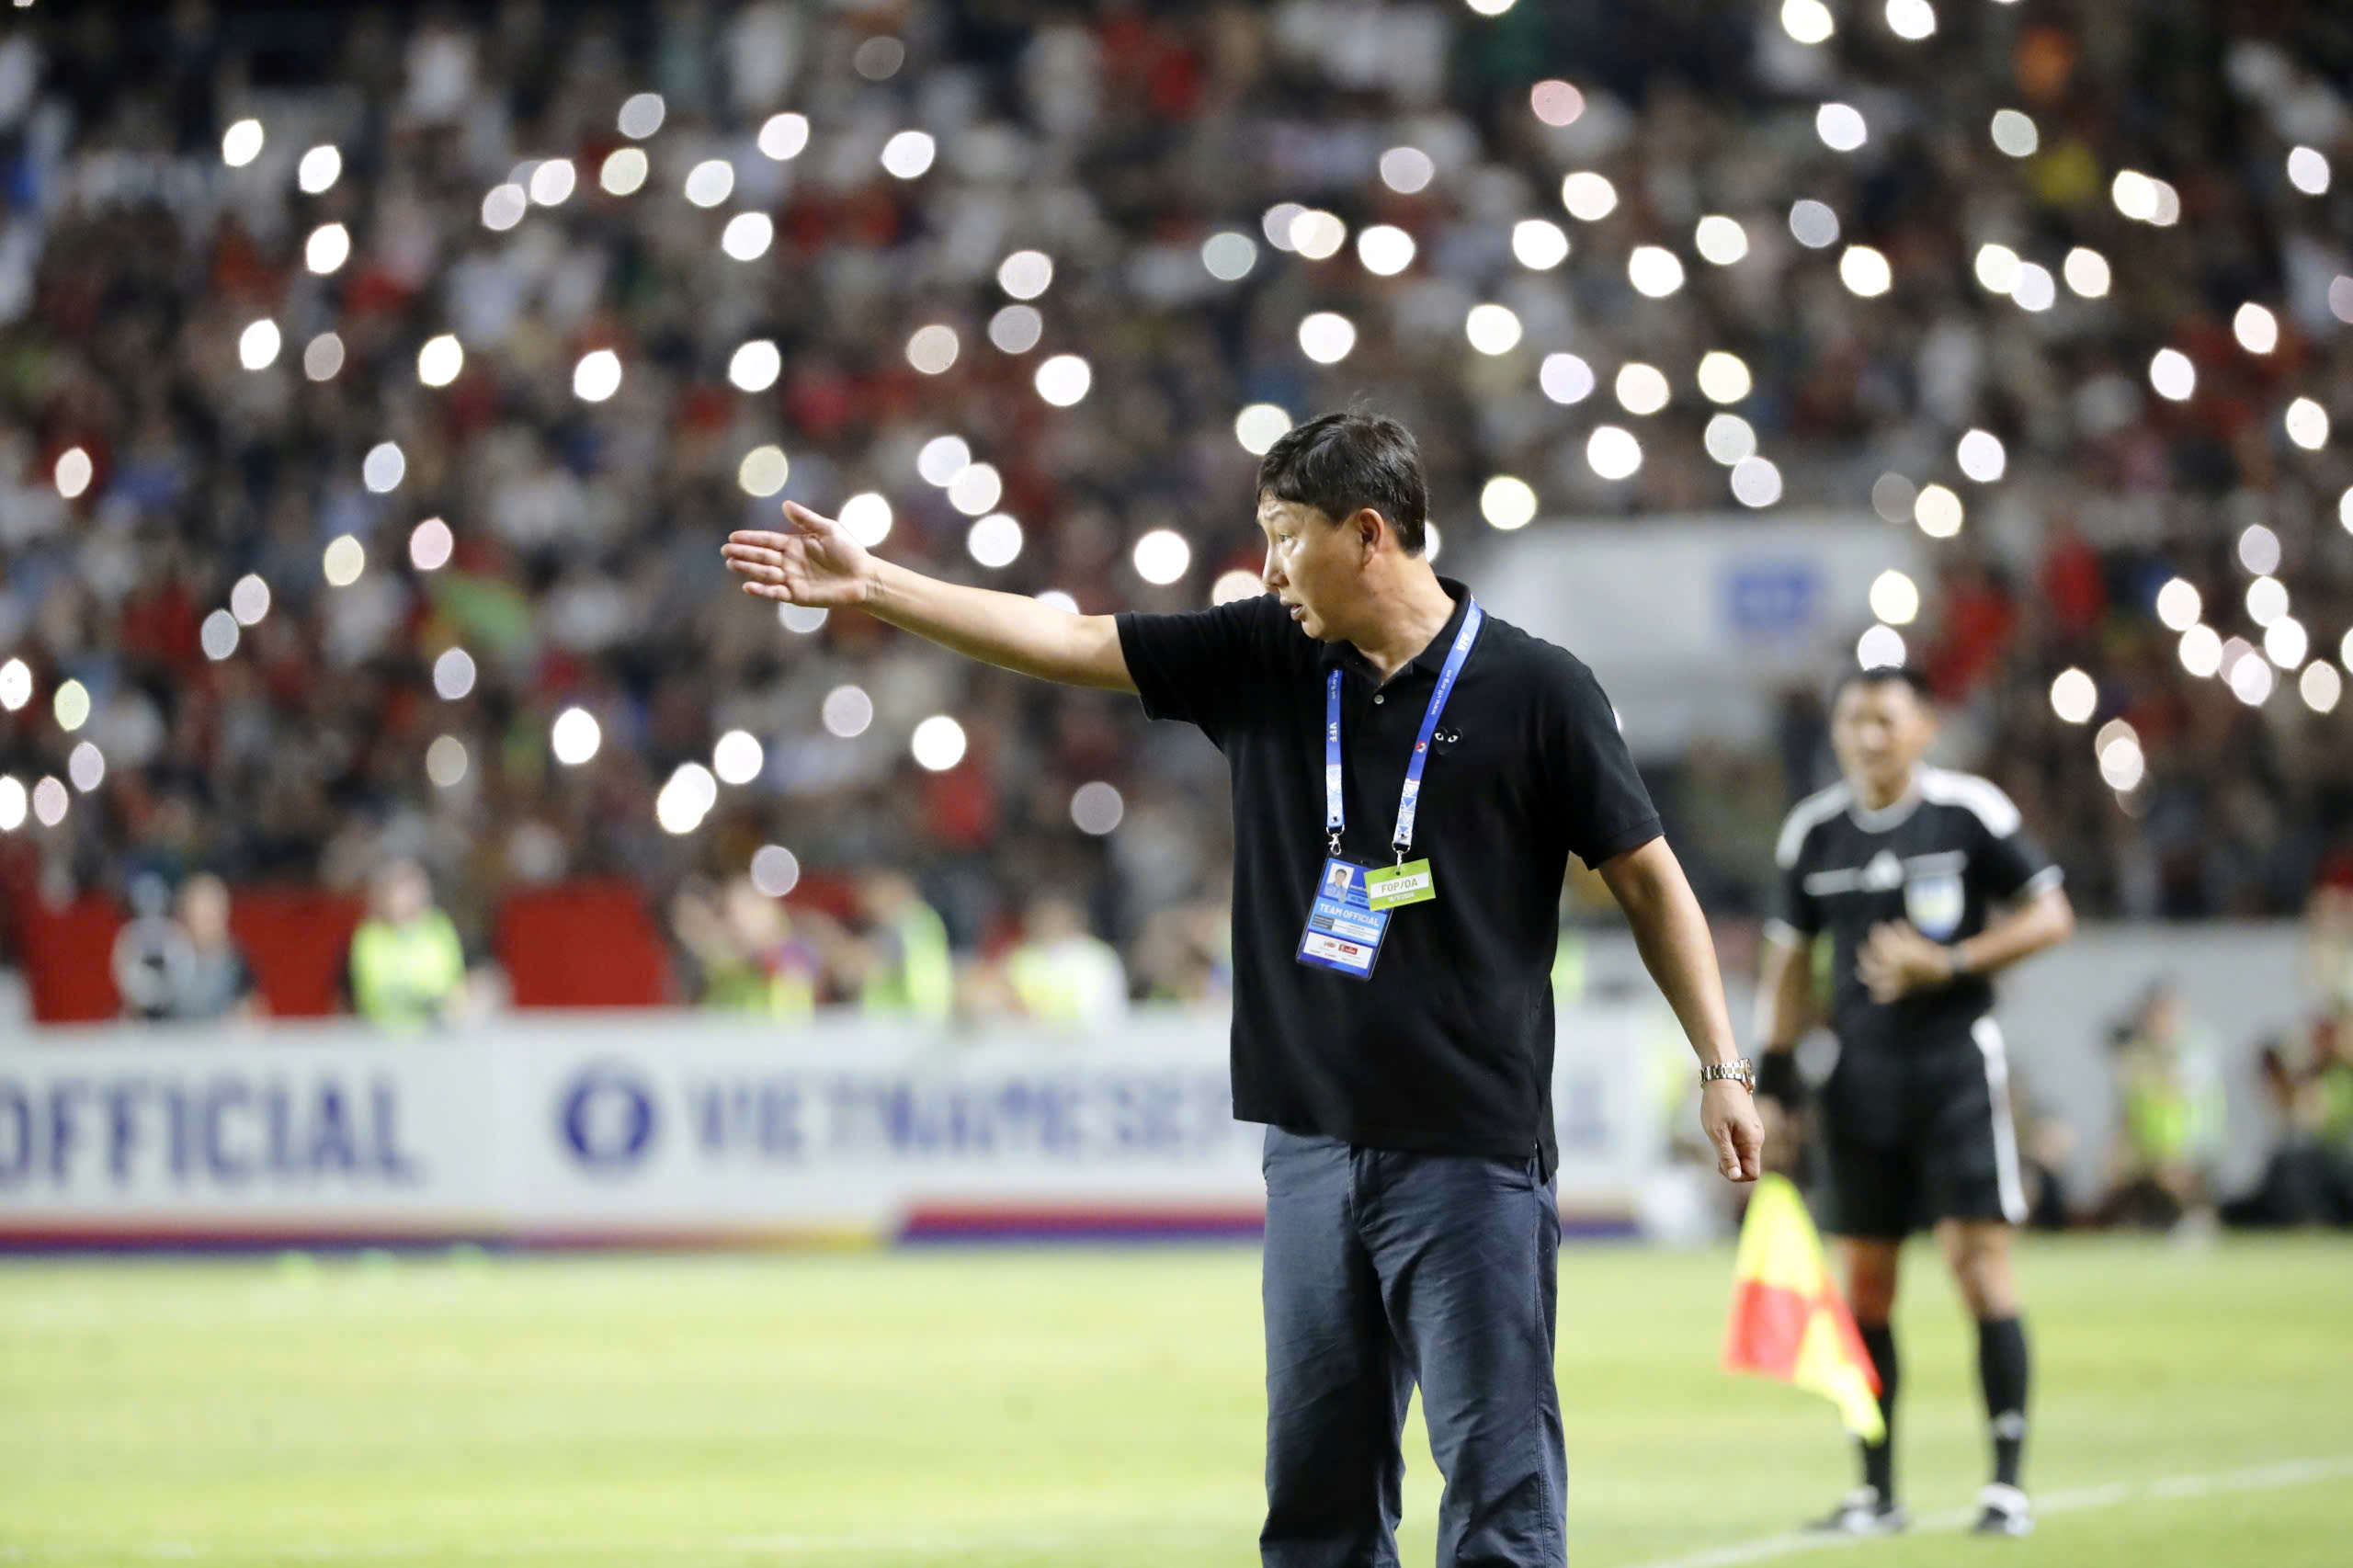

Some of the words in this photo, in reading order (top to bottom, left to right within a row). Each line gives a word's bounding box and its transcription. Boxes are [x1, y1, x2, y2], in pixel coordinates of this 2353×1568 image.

[1455, 631, 1471, 652] VFF
[1430, 669, 1452, 715] www.vff.org.vn
[1329, 722, 1337, 744] VFF
[1319, 903, 1342, 916] TEAM
[1342, 909, 1380, 927] OFFICIAL
